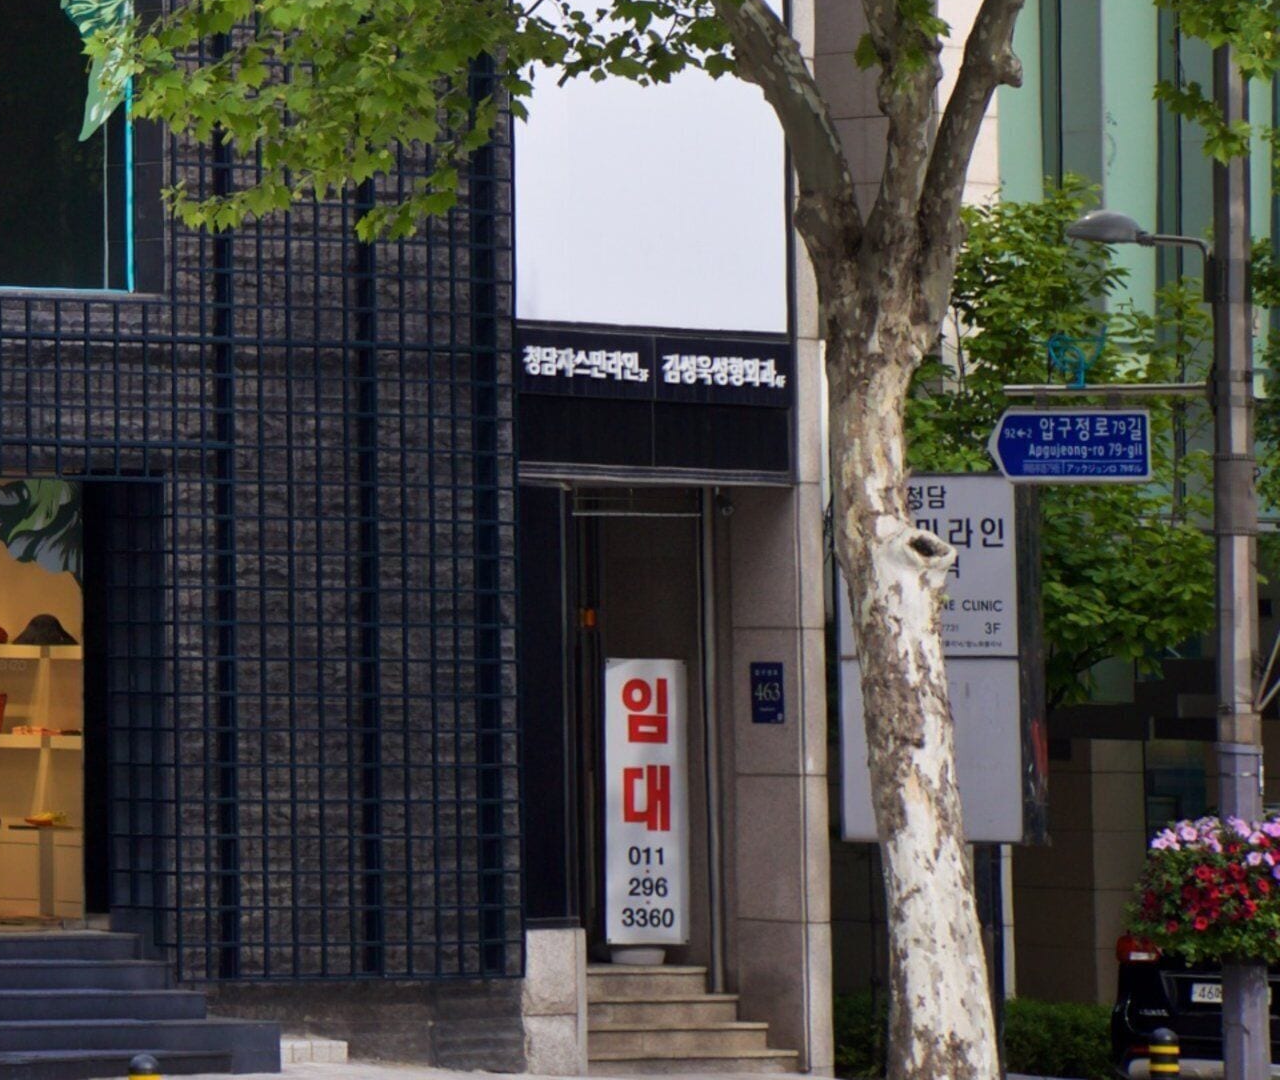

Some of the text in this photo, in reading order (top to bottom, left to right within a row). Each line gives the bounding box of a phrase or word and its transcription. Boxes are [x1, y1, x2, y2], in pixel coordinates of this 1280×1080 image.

[523, 345, 640, 382] 청담쟈스민라인
[662, 354, 776, 388] 김성욱성형외과
[1039, 418, 1142, 441] 압구정로79길
[1028, 443, 1142, 458] Apgujeong-ro 79-gil
[907, 486, 946, 510] 청담
[962, 600, 1003, 612] CLINIC
[985, 622, 1001, 634] 3F
[754, 682, 781, 702] 463
[622, 678, 671, 831] 임대
[628, 846, 665, 865] 011
[628, 877, 668, 897] 296
[622, 908, 674, 928] 3360
